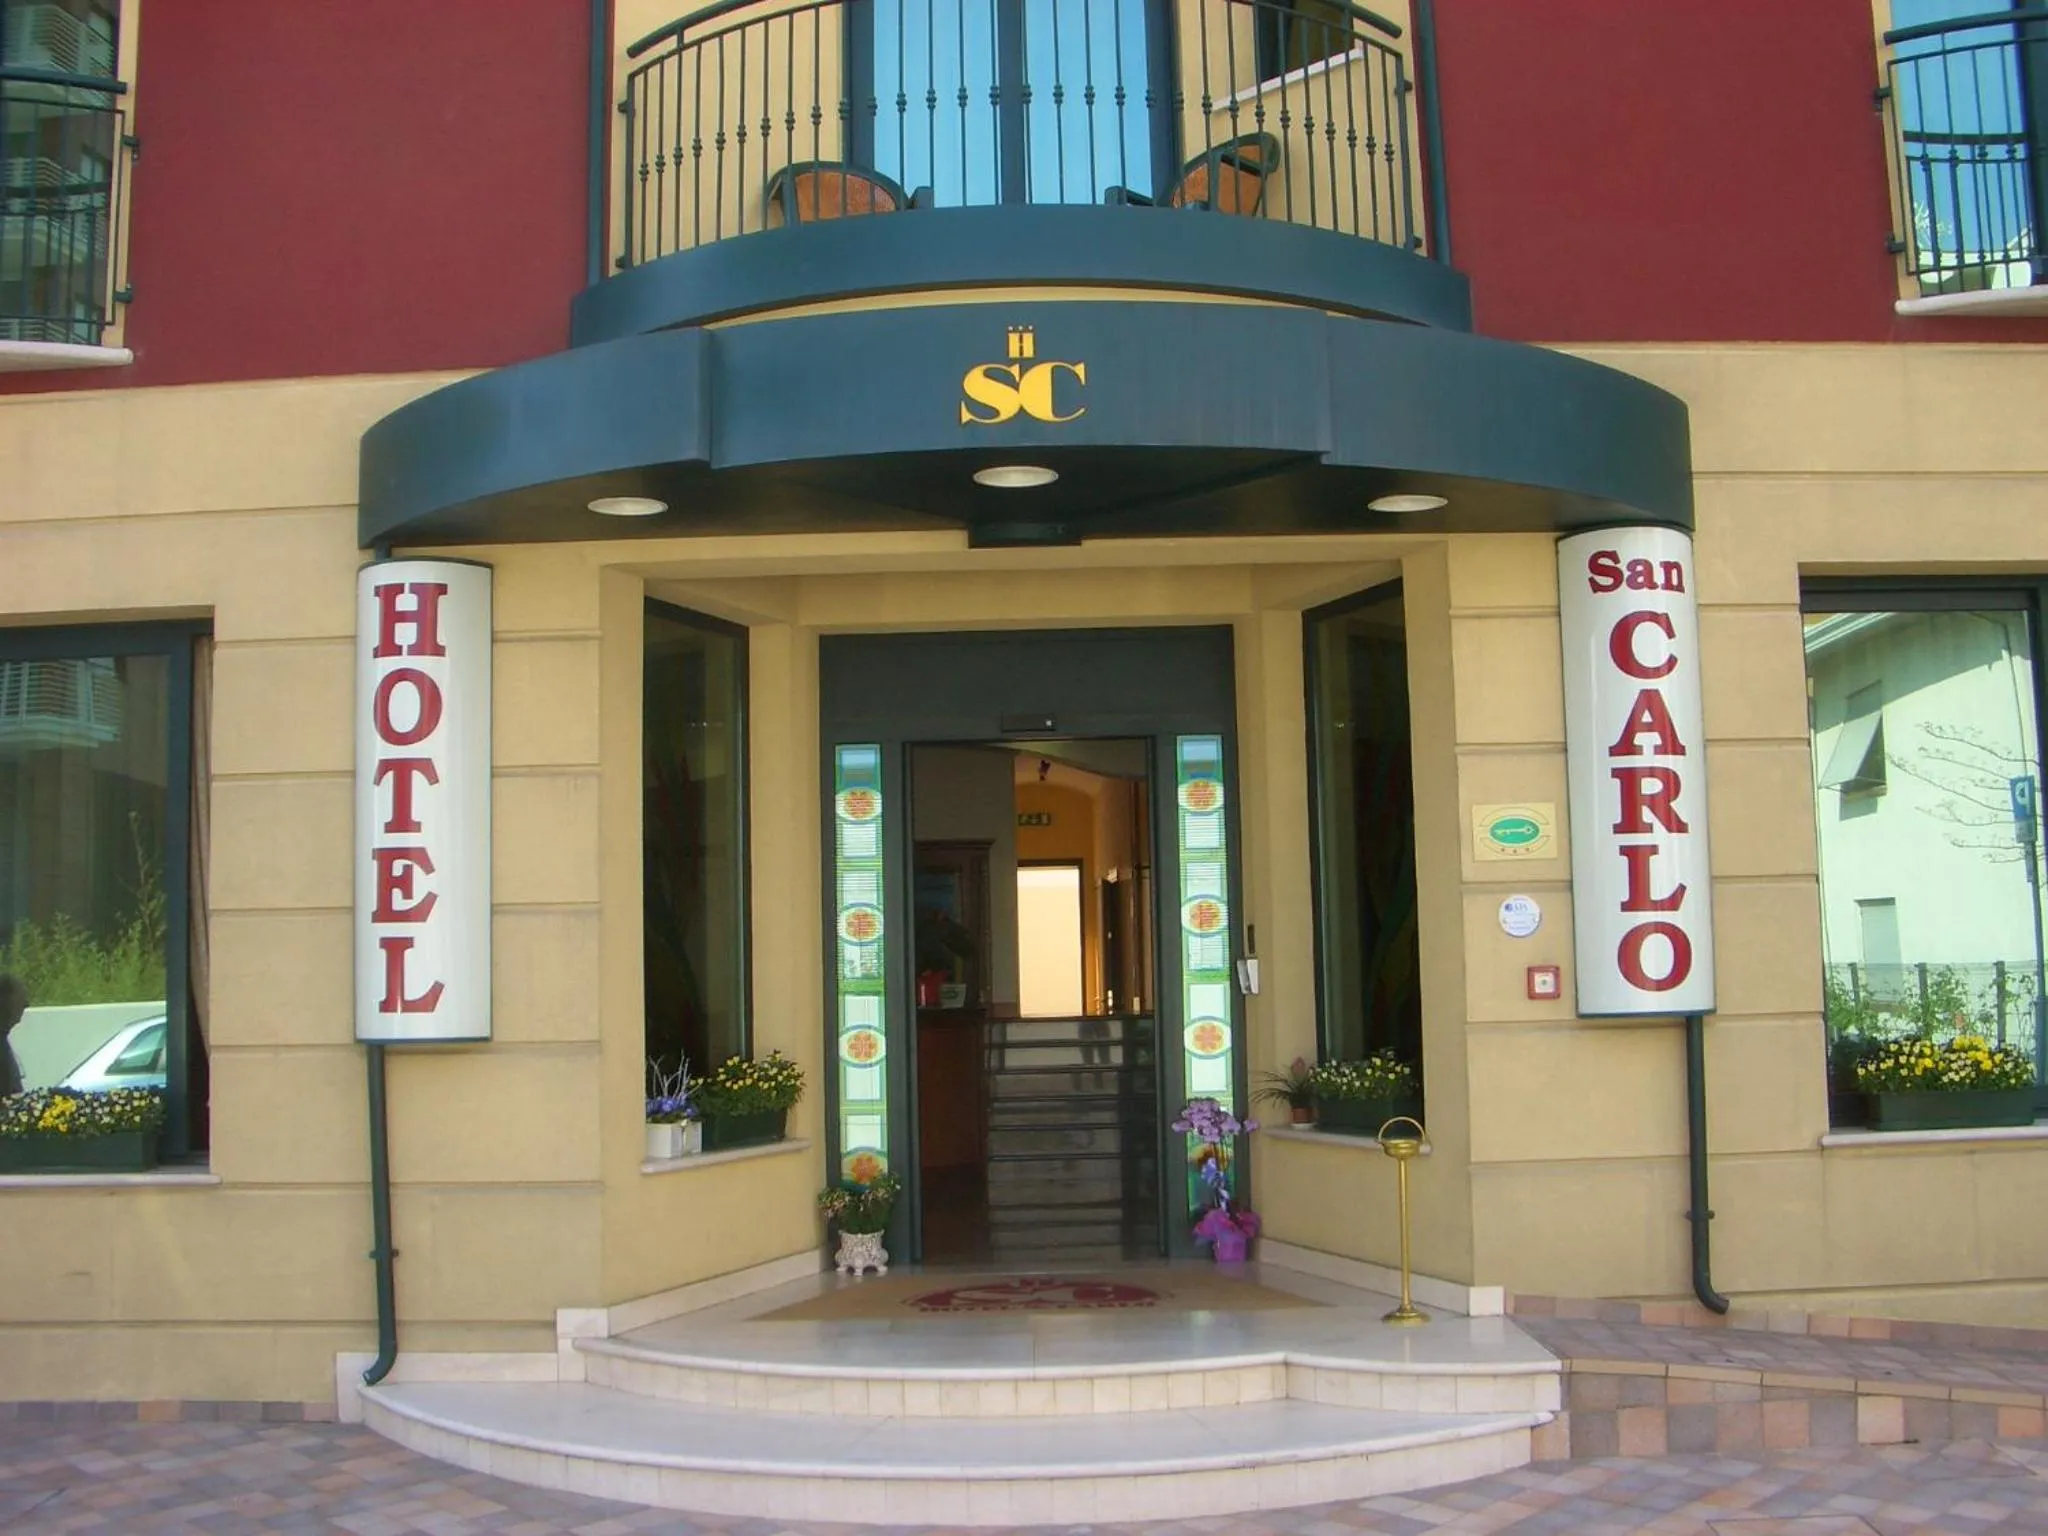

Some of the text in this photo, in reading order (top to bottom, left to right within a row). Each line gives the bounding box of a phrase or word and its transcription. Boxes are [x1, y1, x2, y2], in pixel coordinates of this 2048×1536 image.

[1587, 550, 1686, 595] San
[372, 582, 448, 1014] HOTEL
[1609, 611, 1692, 992] CARLO
